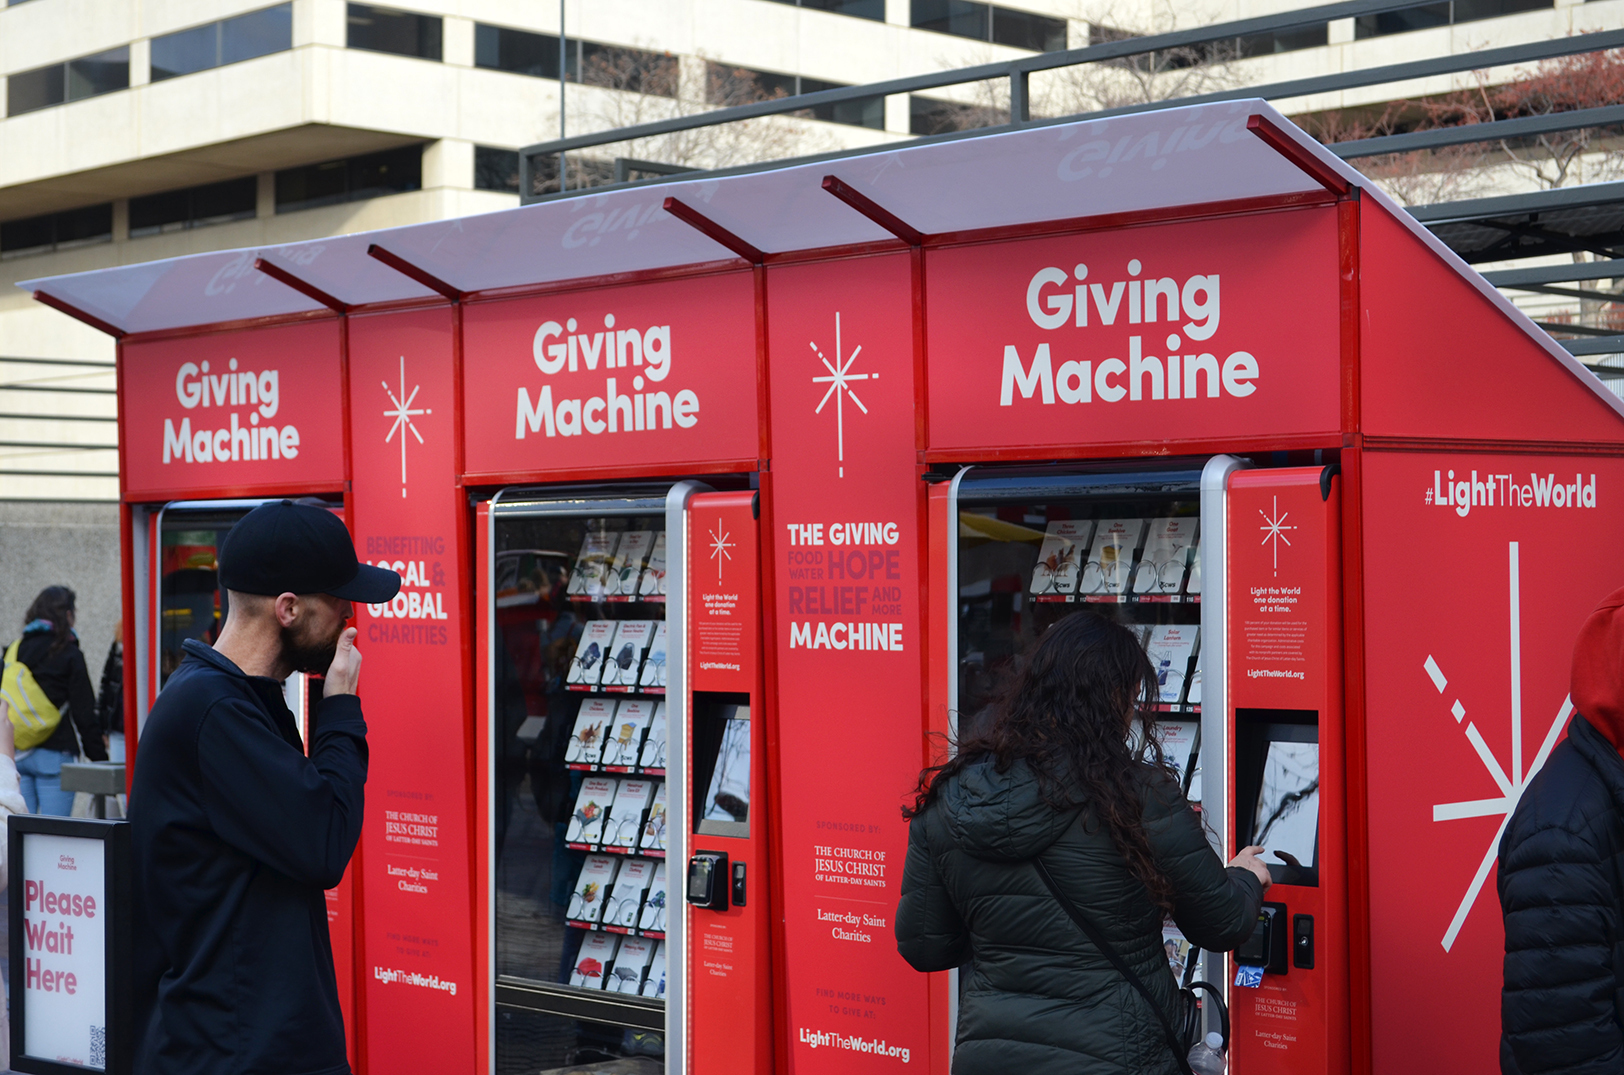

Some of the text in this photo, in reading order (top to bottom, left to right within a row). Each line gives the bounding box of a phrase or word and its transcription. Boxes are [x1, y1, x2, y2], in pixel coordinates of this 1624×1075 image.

[1026, 259, 1221, 342] Giving
[532, 313, 672, 383] Giving
[999, 333, 1260, 407] Machine
[176, 358, 280, 419] Giving
[515, 375, 700, 440] Machine
[162, 412, 300, 464] Machine
[1425, 470, 1597, 517] #LightTheWorld
[787, 522, 900, 546] THE GIVING
[366, 536, 446, 555] BENEFITING
[366, 560, 446, 587] CAL &
[788, 550, 900, 580] FOOD HOPE
[789, 568, 824, 580] WATER
[703, 594, 715, 602] Light
[788, 586, 902, 615] RELIEF AND
[1250, 587, 1267, 596] Light
[1280, 587, 1301, 595] World
[1267, 596, 1298, 604] donation
[872, 604, 902, 615] MORE
[368, 623, 448, 645] CHARITIES
[789, 621, 904, 651] MACHINE
[1247, 669, 1305, 680] LightTheWorld.org
[385, 810, 438, 825] THE CHURCH OF
[816, 820, 881, 834] SPONSORED BY:
[385, 821, 438, 839] JESUS CHRIST
[59, 854, 75, 865] Giving
[814, 845, 886, 861] THE CHURCH OF
[57, 862, 77, 871] Machine
[387, 864, 438, 881] Latter-day Saint
[815, 858, 886, 877] JESUS CHRIST
[398, 880, 428, 894] Charities
[815, 873, 886, 888] OF LATTER-DAY SAINTS
[25, 879, 97, 919] Please
[817, 908, 886, 928] Latter-day Saint
[24, 918, 74, 955] Wait
[832, 927, 871, 943] Charities
[26, 956, 77, 995] Here
[374, 966, 457, 995] LightTheWorld.org
[816, 988, 886, 1005] FIND MORE WAYS
[829, 1004, 876, 1020] TO GIVE AT:
[799, 1028, 910, 1063] LightTheWorld.org
